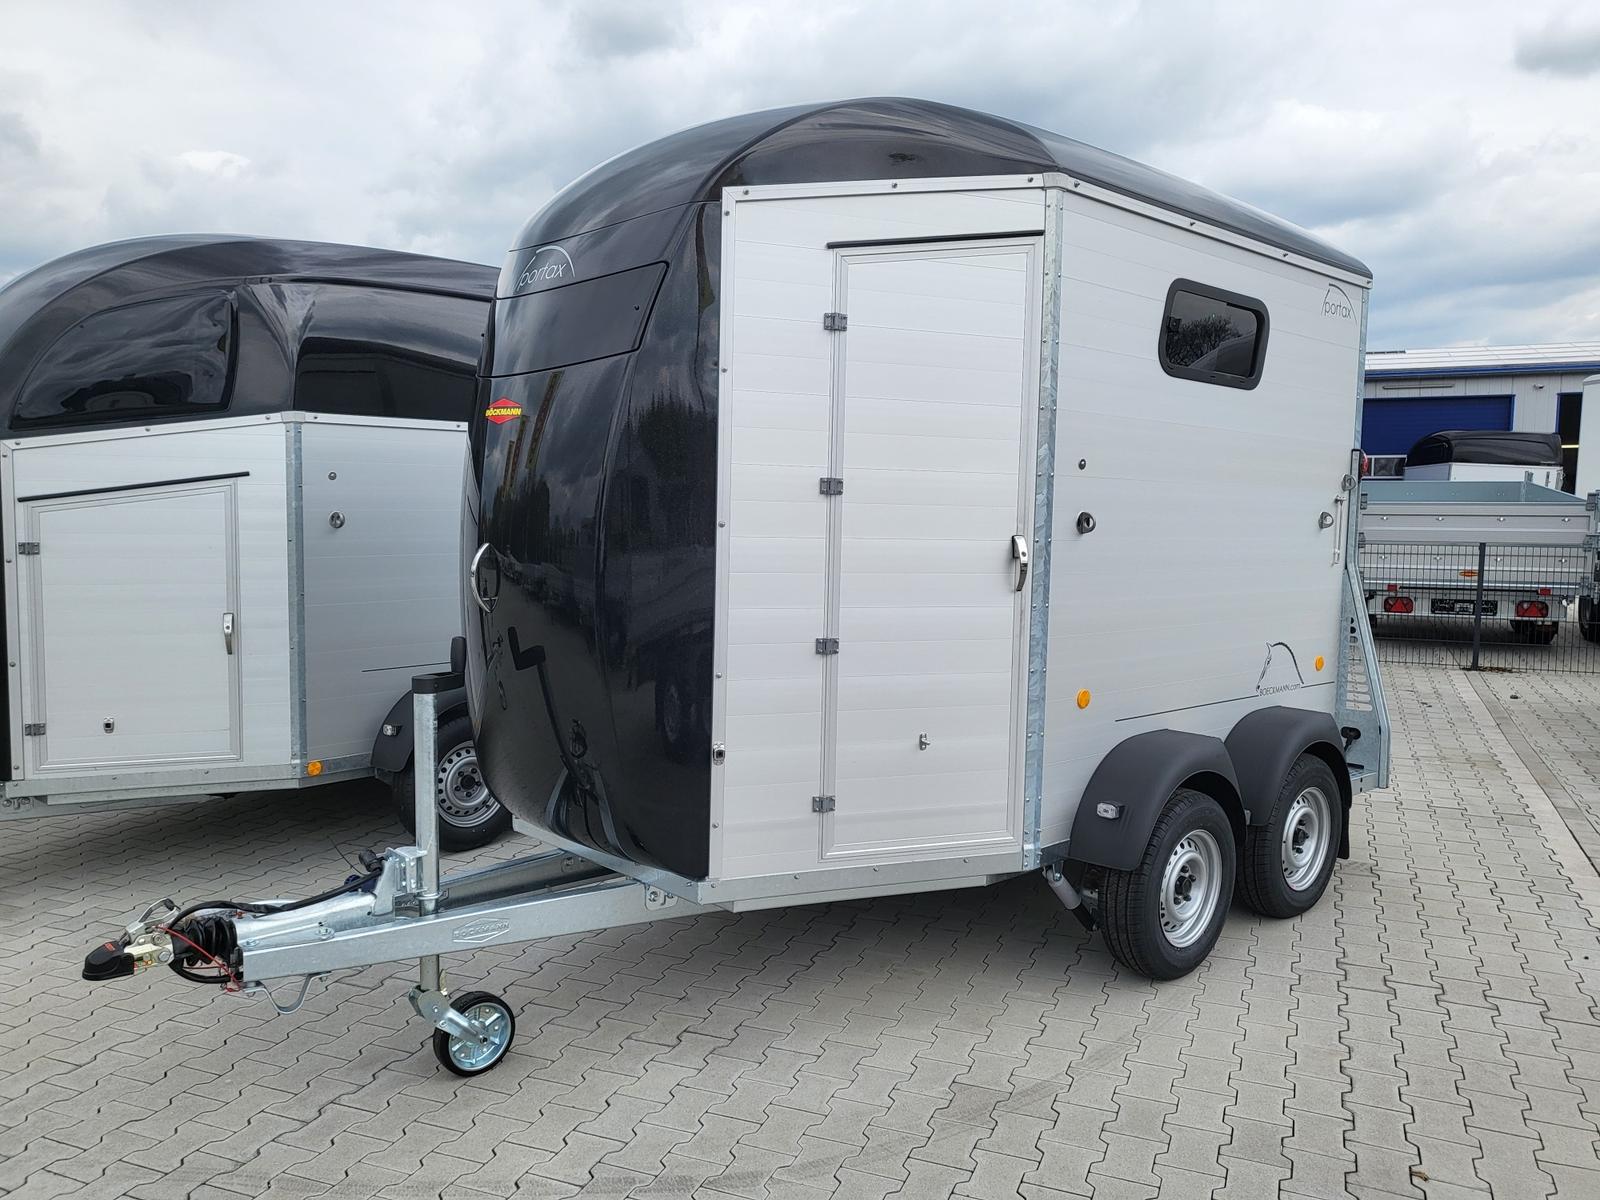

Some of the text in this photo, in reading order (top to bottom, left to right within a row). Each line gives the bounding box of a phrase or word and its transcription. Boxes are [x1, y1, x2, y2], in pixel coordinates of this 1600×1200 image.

[515, 262, 567, 291] portax
[1323, 300, 1352, 319] portax
[485, 407, 522, 417] BÖCKMANN
